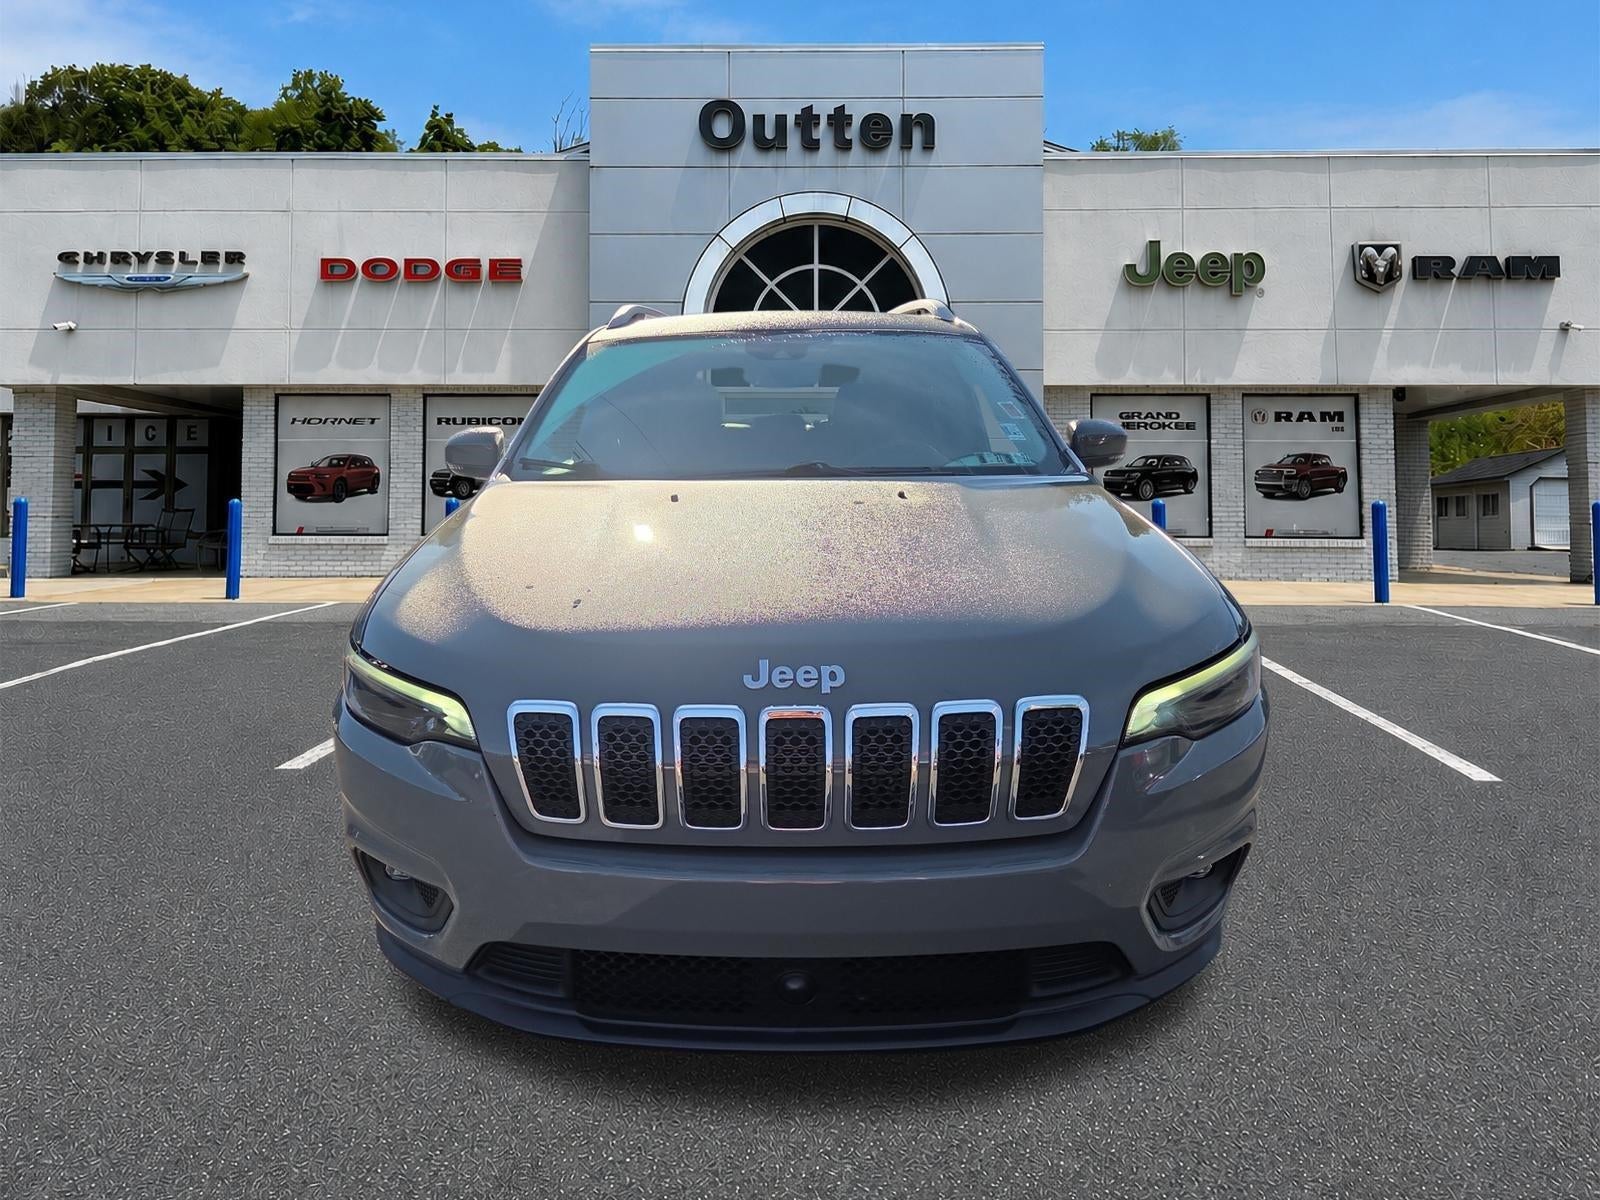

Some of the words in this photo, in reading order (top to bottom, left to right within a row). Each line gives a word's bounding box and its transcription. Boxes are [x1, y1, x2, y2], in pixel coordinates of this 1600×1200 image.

[699, 99, 936, 151] Outten
[57, 251, 247, 266] CHRYSLER
[1123, 240, 1266, 296] Jeep
[1411, 255, 1561, 280] RAM
[319, 256, 524, 283] DODGE
[290, 417, 381, 426] HORNET
[1118, 411, 1181, 420] GRAND
[1274, 411, 1344, 423] RAM
[1121, 421, 1197, 431] EROKEE
[743, 659, 846, 694] Jeep
